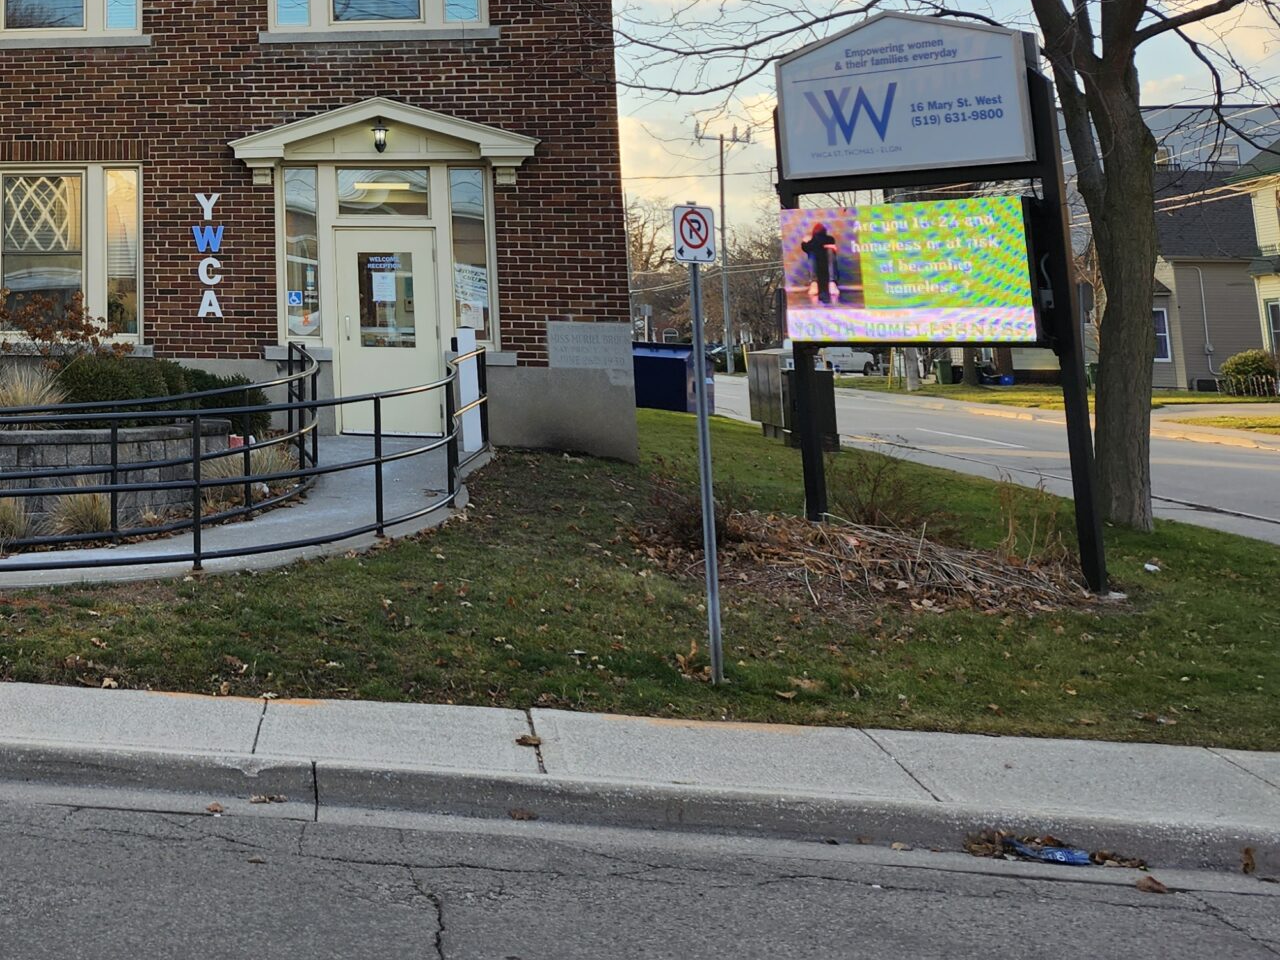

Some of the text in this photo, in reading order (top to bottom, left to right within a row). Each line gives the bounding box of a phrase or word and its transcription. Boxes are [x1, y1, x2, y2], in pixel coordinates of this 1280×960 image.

[844, 39, 944, 59] Empowering women
[834, 48, 957, 71] & their families everyday
[910, 95, 1003, 113] 16 Mary St. West
[911, 108, 1004, 128] (519) 631-9800
